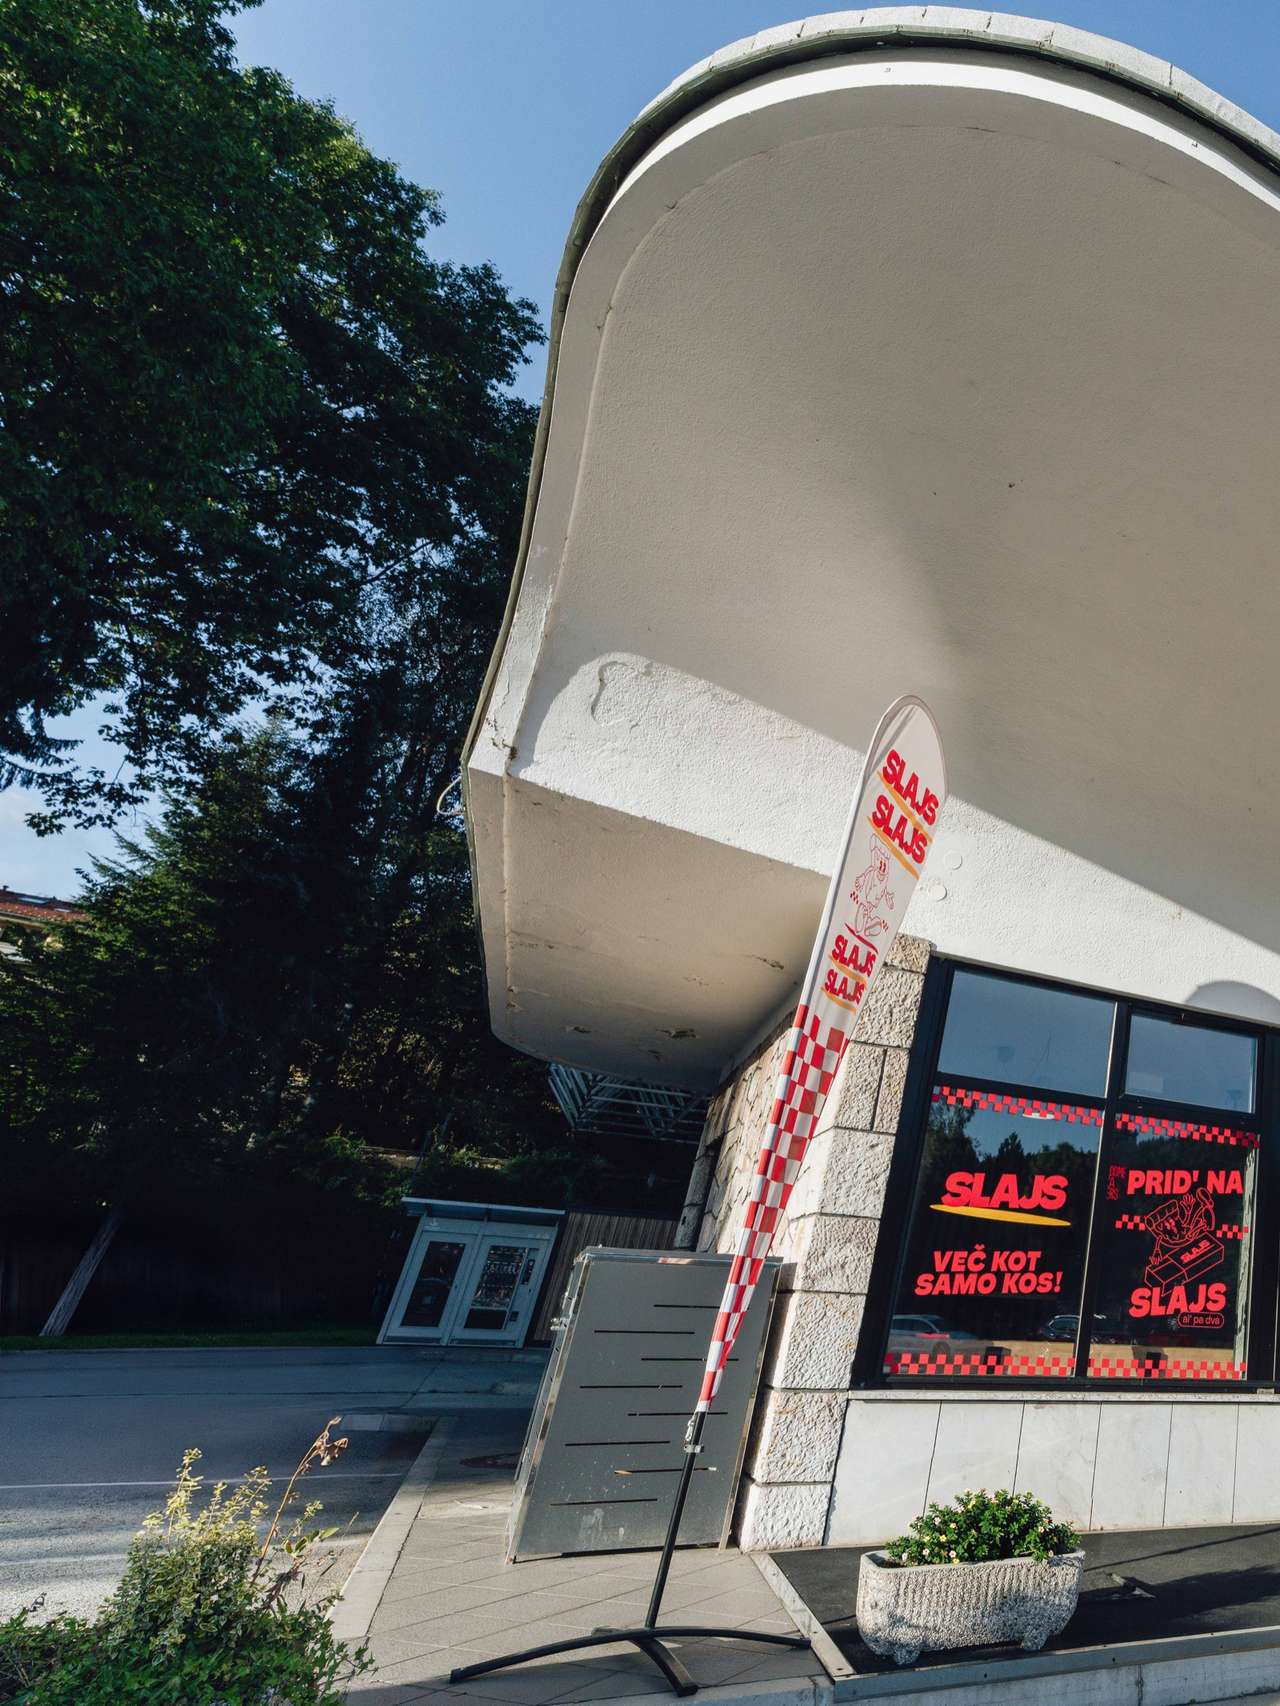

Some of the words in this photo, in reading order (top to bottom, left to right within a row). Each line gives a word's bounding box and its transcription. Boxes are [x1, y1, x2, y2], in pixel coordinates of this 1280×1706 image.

[882, 749, 939, 826] SLAJS
[872, 794, 928, 864] SLAJS
[832, 934, 876, 977] SLAJS
[825, 969, 865, 1004] SLAJS
[940, 1171, 1069, 1210] SLAJS
[1126, 1170, 1200, 1195] PRID'
[1206, 1170, 1244, 1194] NA
[933, 1244, 987, 1272] VEČ
[991, 1251, 1042, 1272] KOT
[914, 1272, 998, 1296] SAMO
[1001, 1271, 1064, 1295] KOS!
[1128, 1282, 1227, 1318] SLAJS
